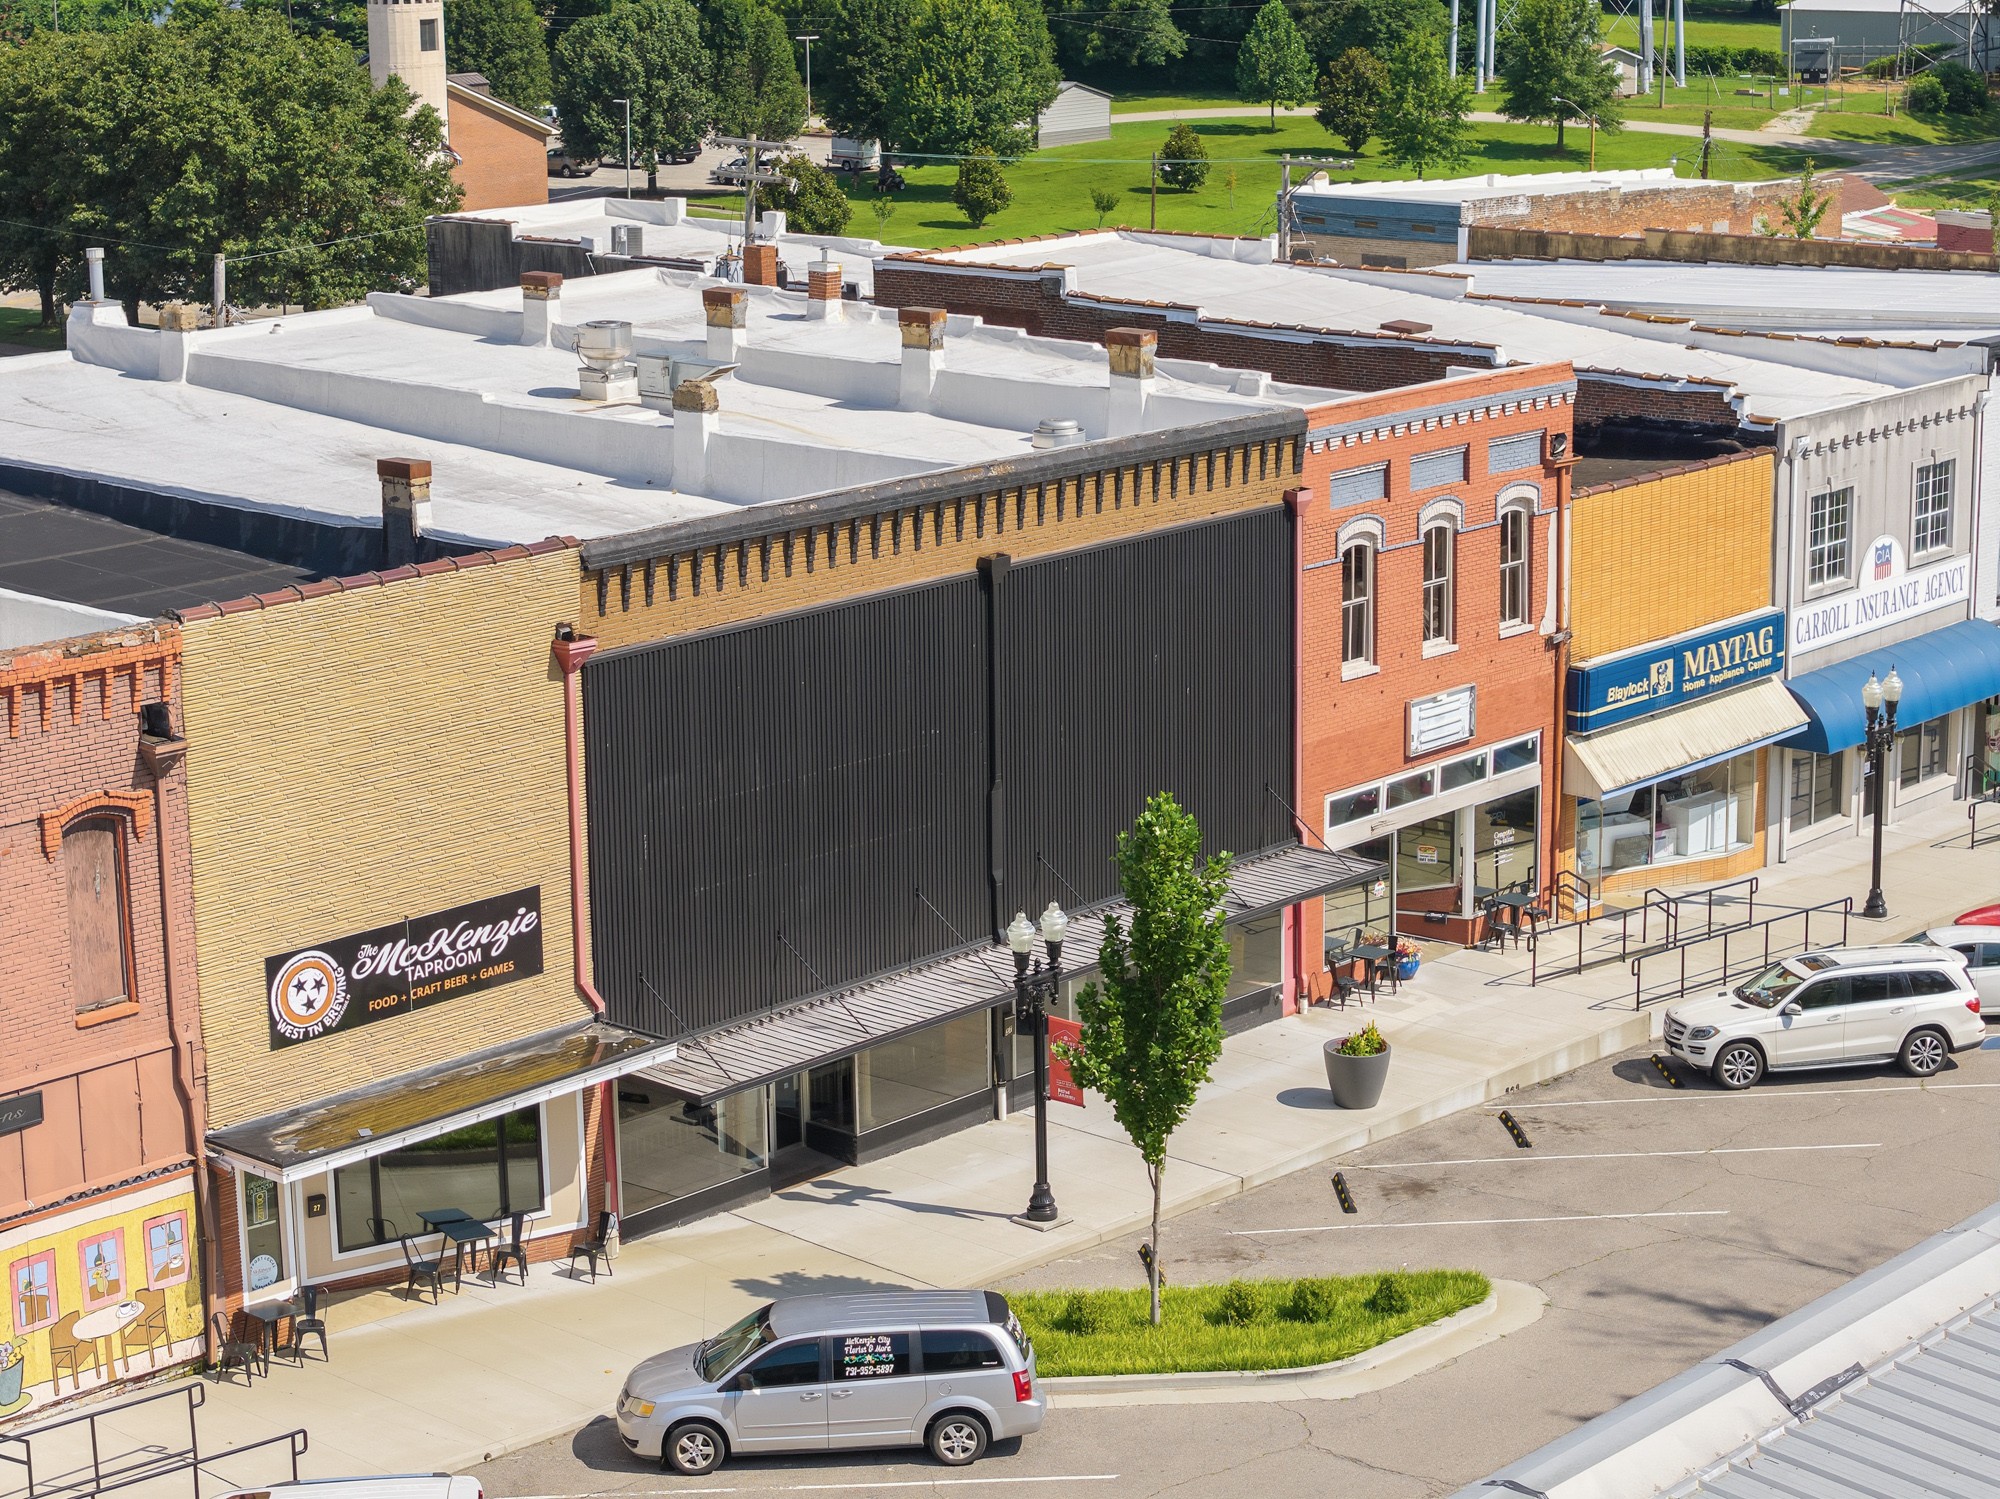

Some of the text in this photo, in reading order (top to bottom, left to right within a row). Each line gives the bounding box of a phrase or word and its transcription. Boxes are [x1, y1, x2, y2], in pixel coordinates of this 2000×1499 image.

[1875, 548, 1891, 565] CIA
[1796, 565, 1966, 644] CARROLL INSURANCE AGENCY
[1682, 626, 1773, 681] MAYTAG
[1607, 678, 1649, 703] Blaylock
[1682, 657, 1773, 693] Home Appliance Center
[351, 907, 538, 980] McKenzie
[358, 944, 379, 959] The
[405, 948, 482, 981] TAPROOM
[276, 1019, 306, 1039] WEST
[308, 1023, 324, 1038] TN
[322, 966, 347, 1027] BREWING
[369, 994, 398, 1011] FOOD
[411, 981, 442, 1000] CRAFT
[444, 974, 468, 990] BEER
[480, 961, 515, 980] GAMES
[314, 1204, 321, 1212] 27
[875, 1345, 891, 1353] More
